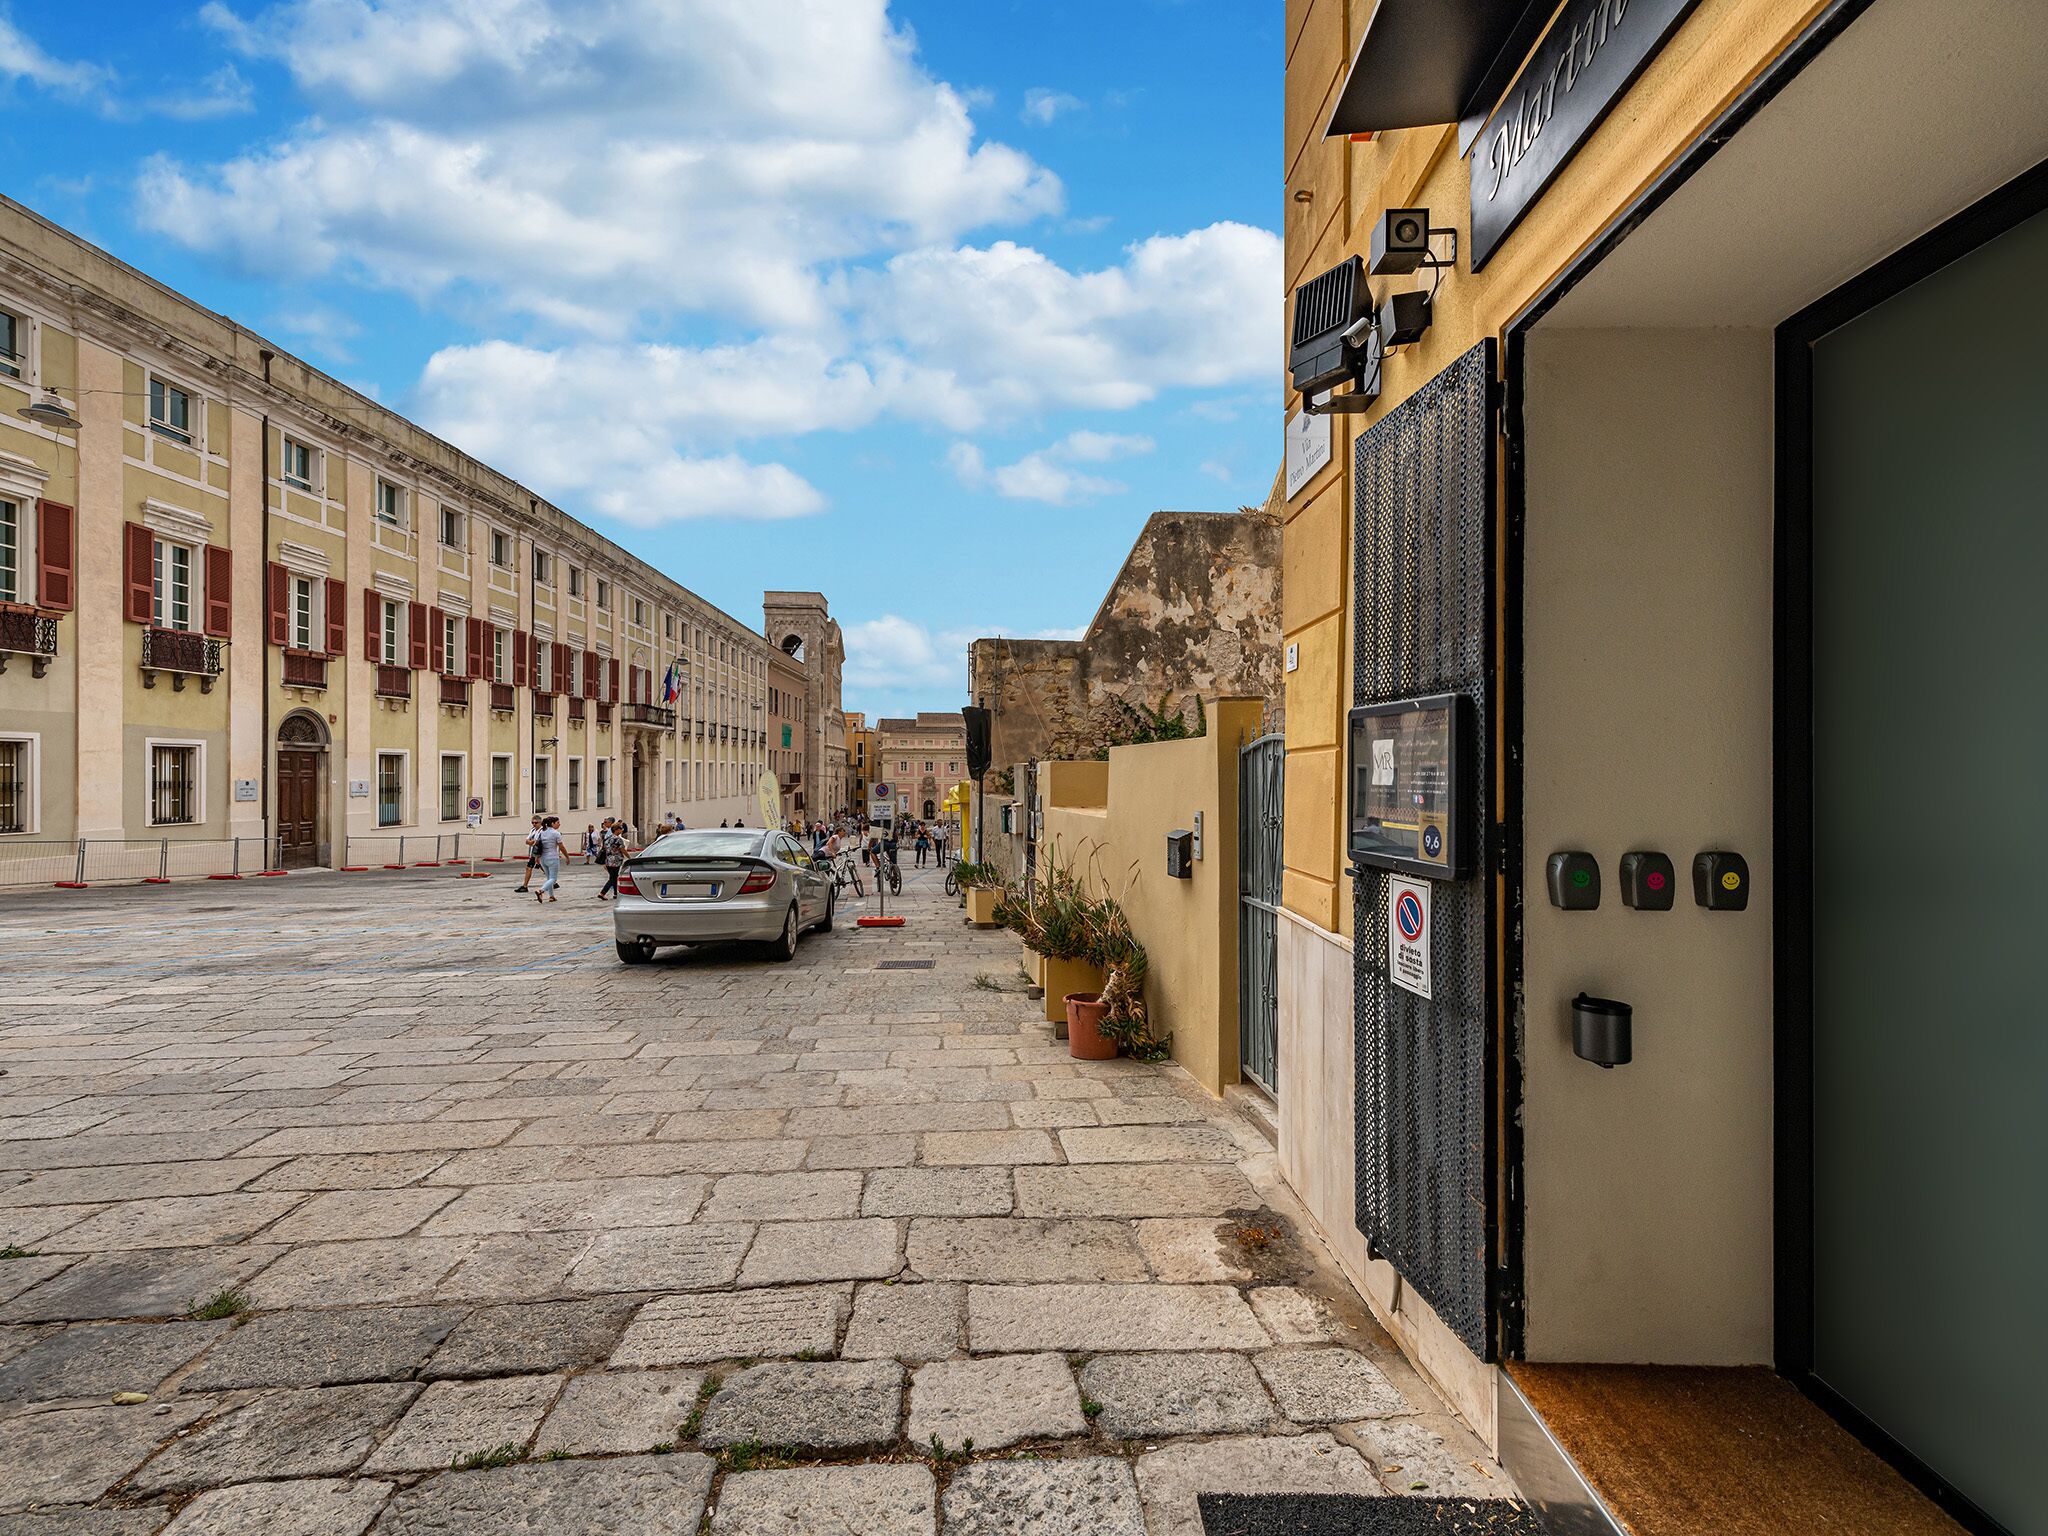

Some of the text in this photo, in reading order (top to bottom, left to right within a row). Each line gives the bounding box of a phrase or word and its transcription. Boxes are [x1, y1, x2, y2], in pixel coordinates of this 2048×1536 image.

[1302, 438, 1312, 454] Via
[1425, 835, 1440, 850] 9,6
[1400, 943, 1421, 958] divieto
[1398, 951, 1423, 967] di sosta
